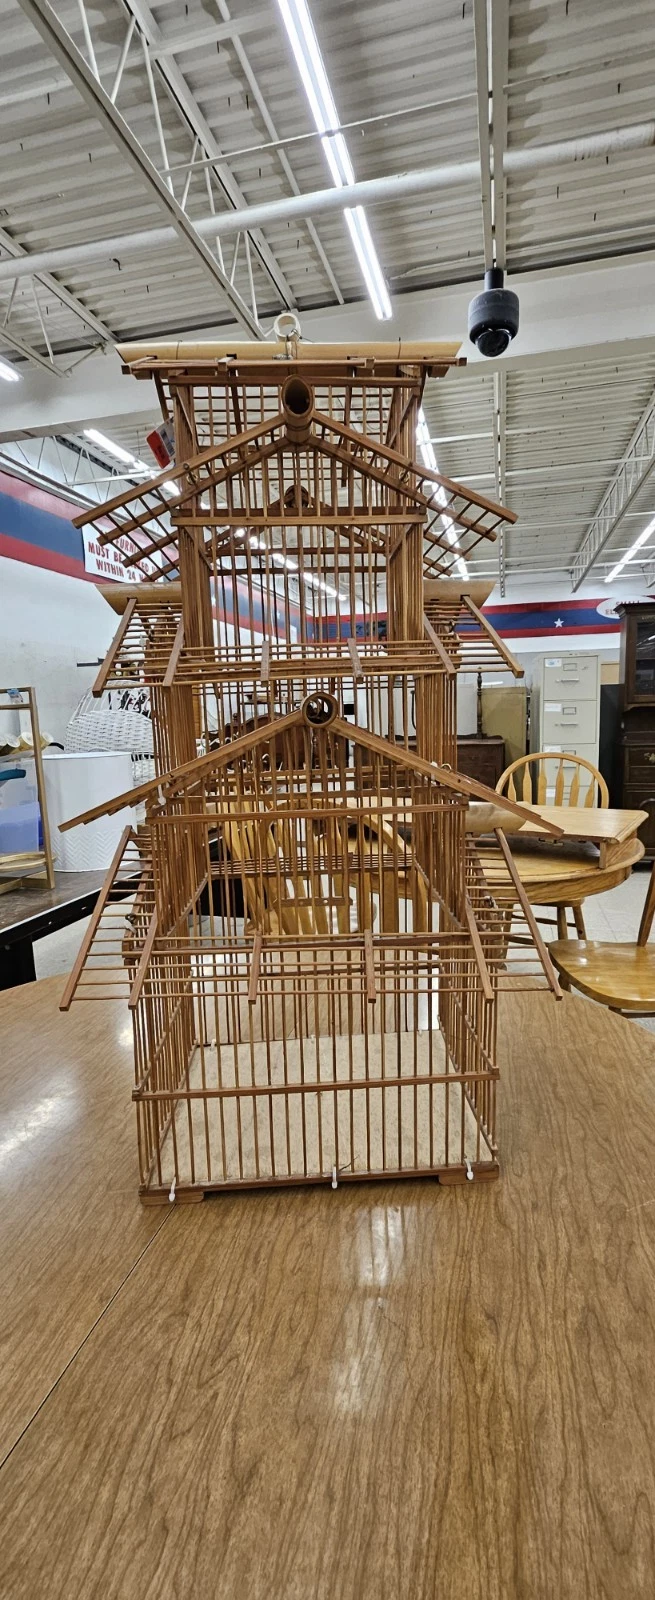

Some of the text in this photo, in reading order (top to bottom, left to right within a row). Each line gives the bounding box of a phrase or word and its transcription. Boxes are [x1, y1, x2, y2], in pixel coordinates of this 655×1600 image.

[88, 541, 109, 558] MUST
[114, 551, 123, 563] BE
[96, 558, 124, 577] WITHIN
[127, 569, 136, 581] 24
